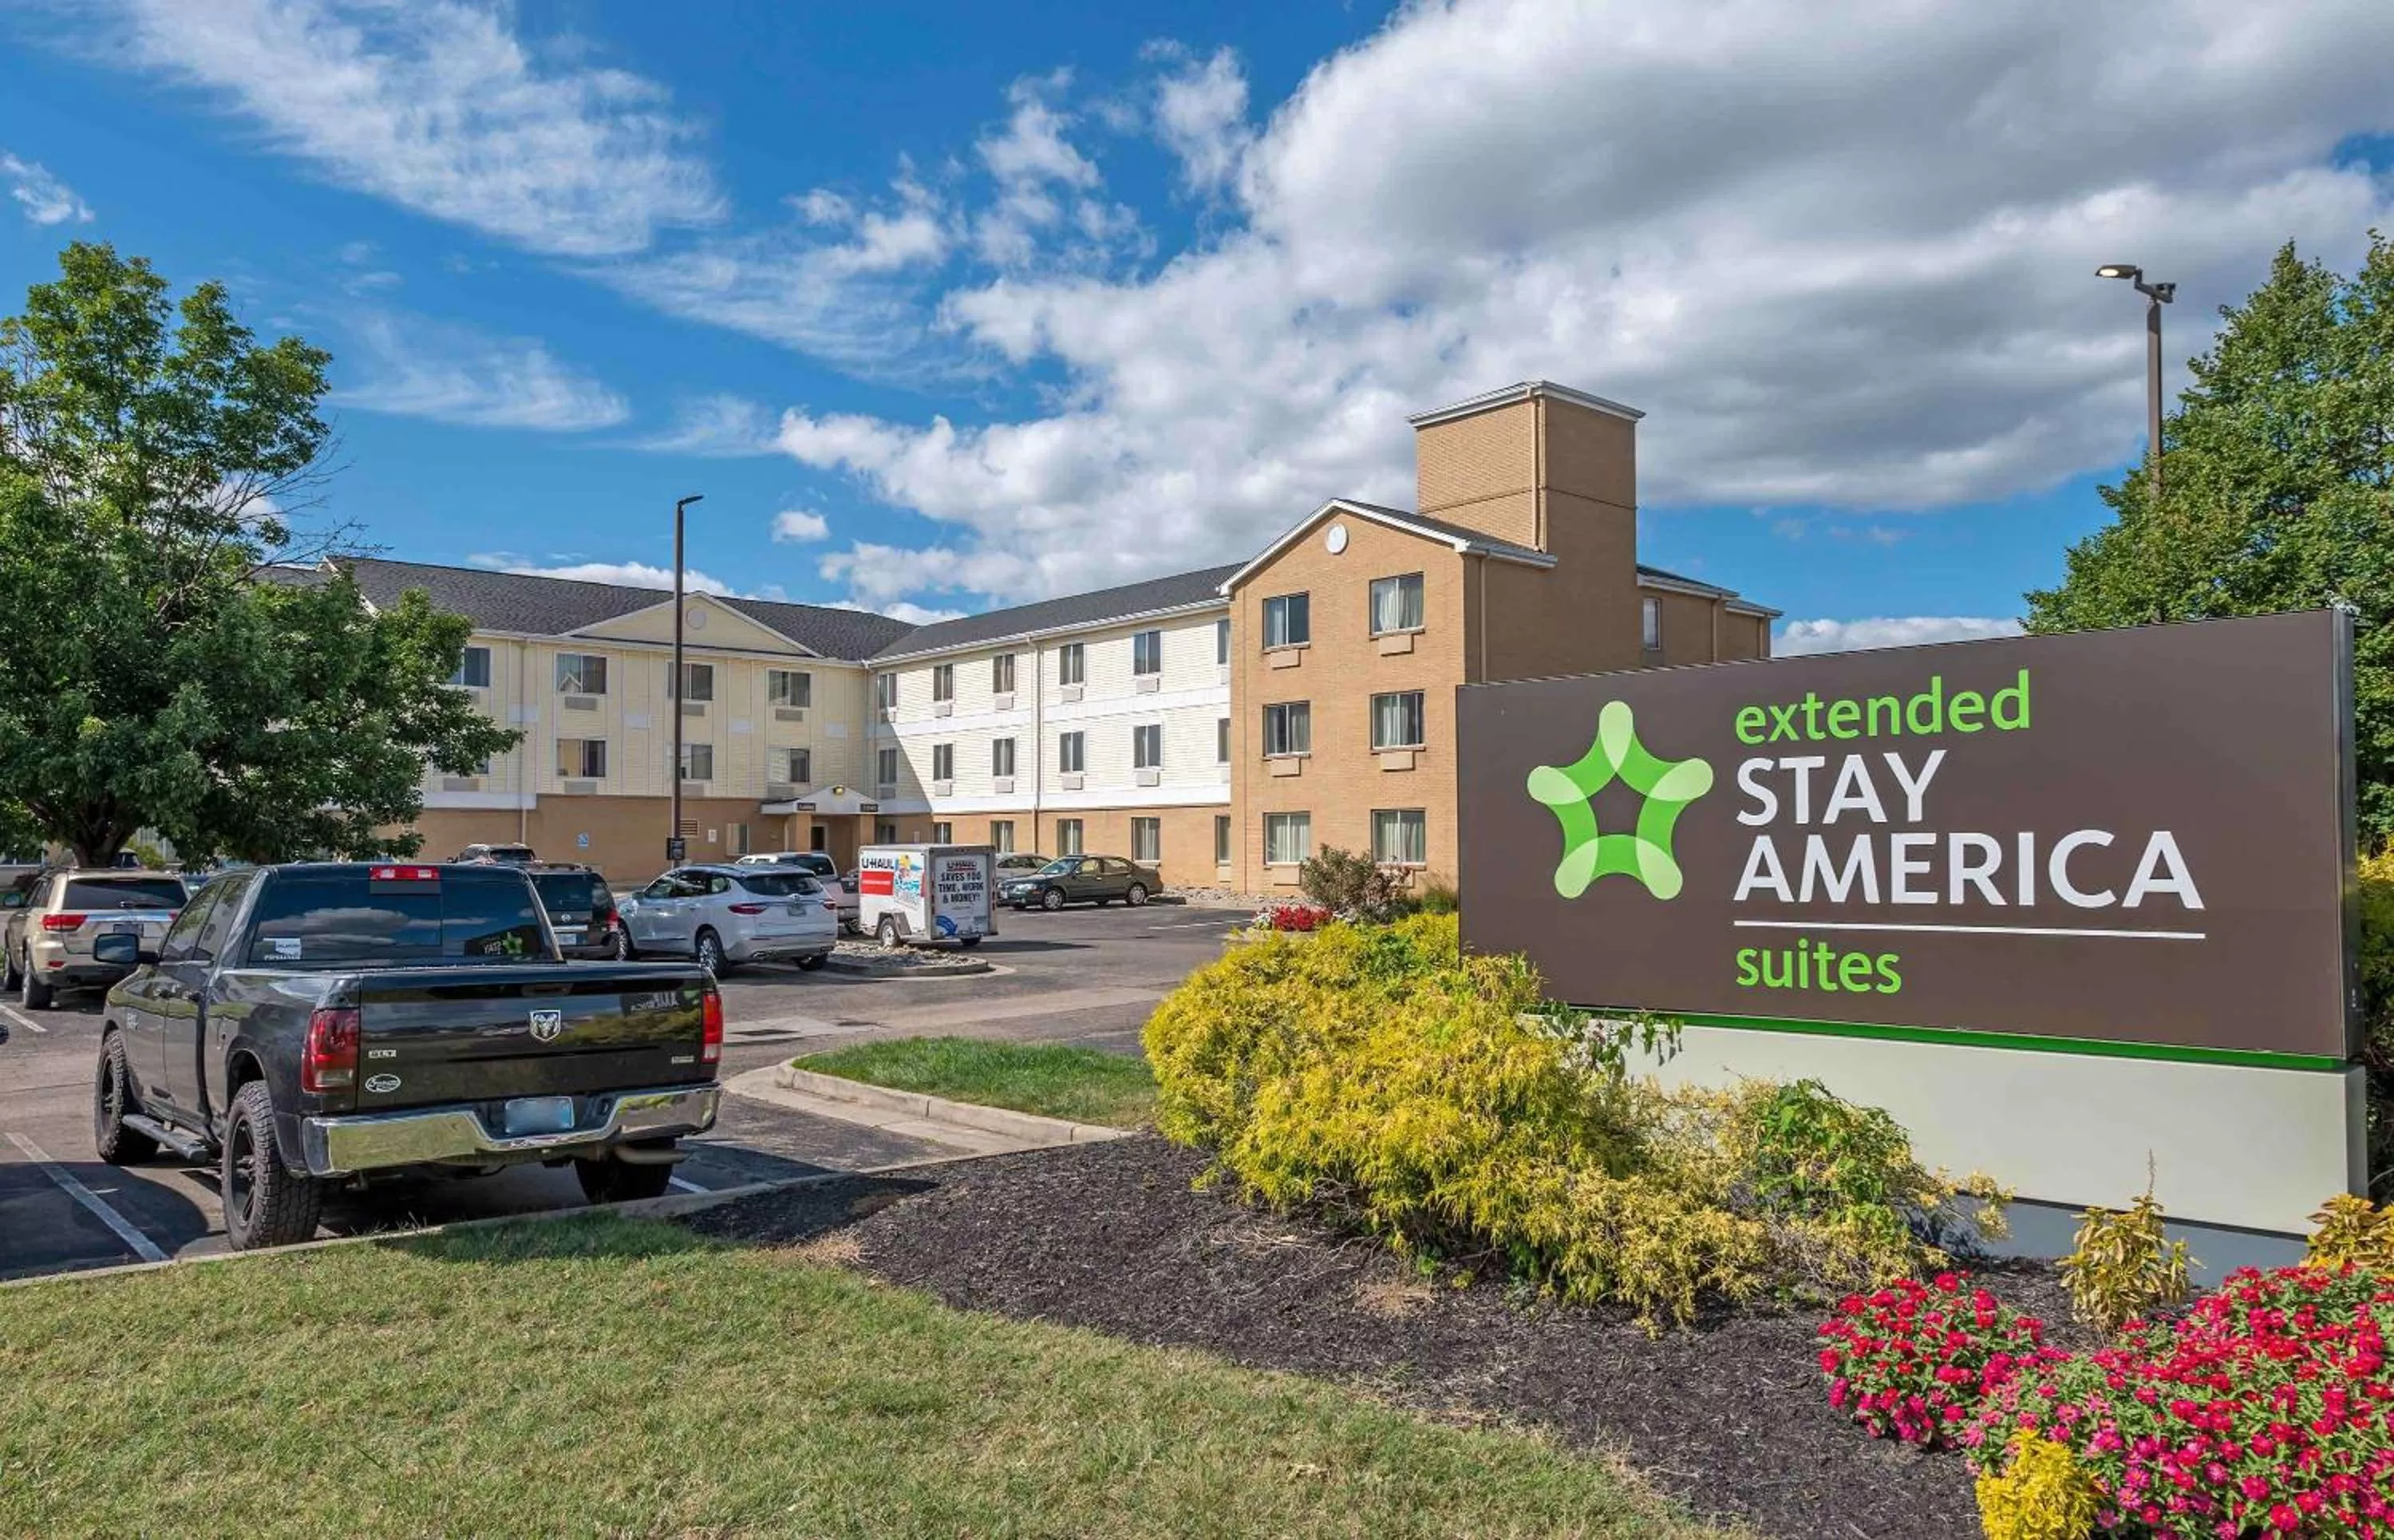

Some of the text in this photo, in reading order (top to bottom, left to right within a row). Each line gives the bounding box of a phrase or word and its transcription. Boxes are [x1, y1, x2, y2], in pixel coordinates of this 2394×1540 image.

[1736, 670, 2031, 744] extended
[1735, 749, 1946, 826] STAY
[862, 858, 894, 869] U-HAUL
[1733, 829, 2205, 910] AMERICA
[1736, 938, 1902, 994] suites
